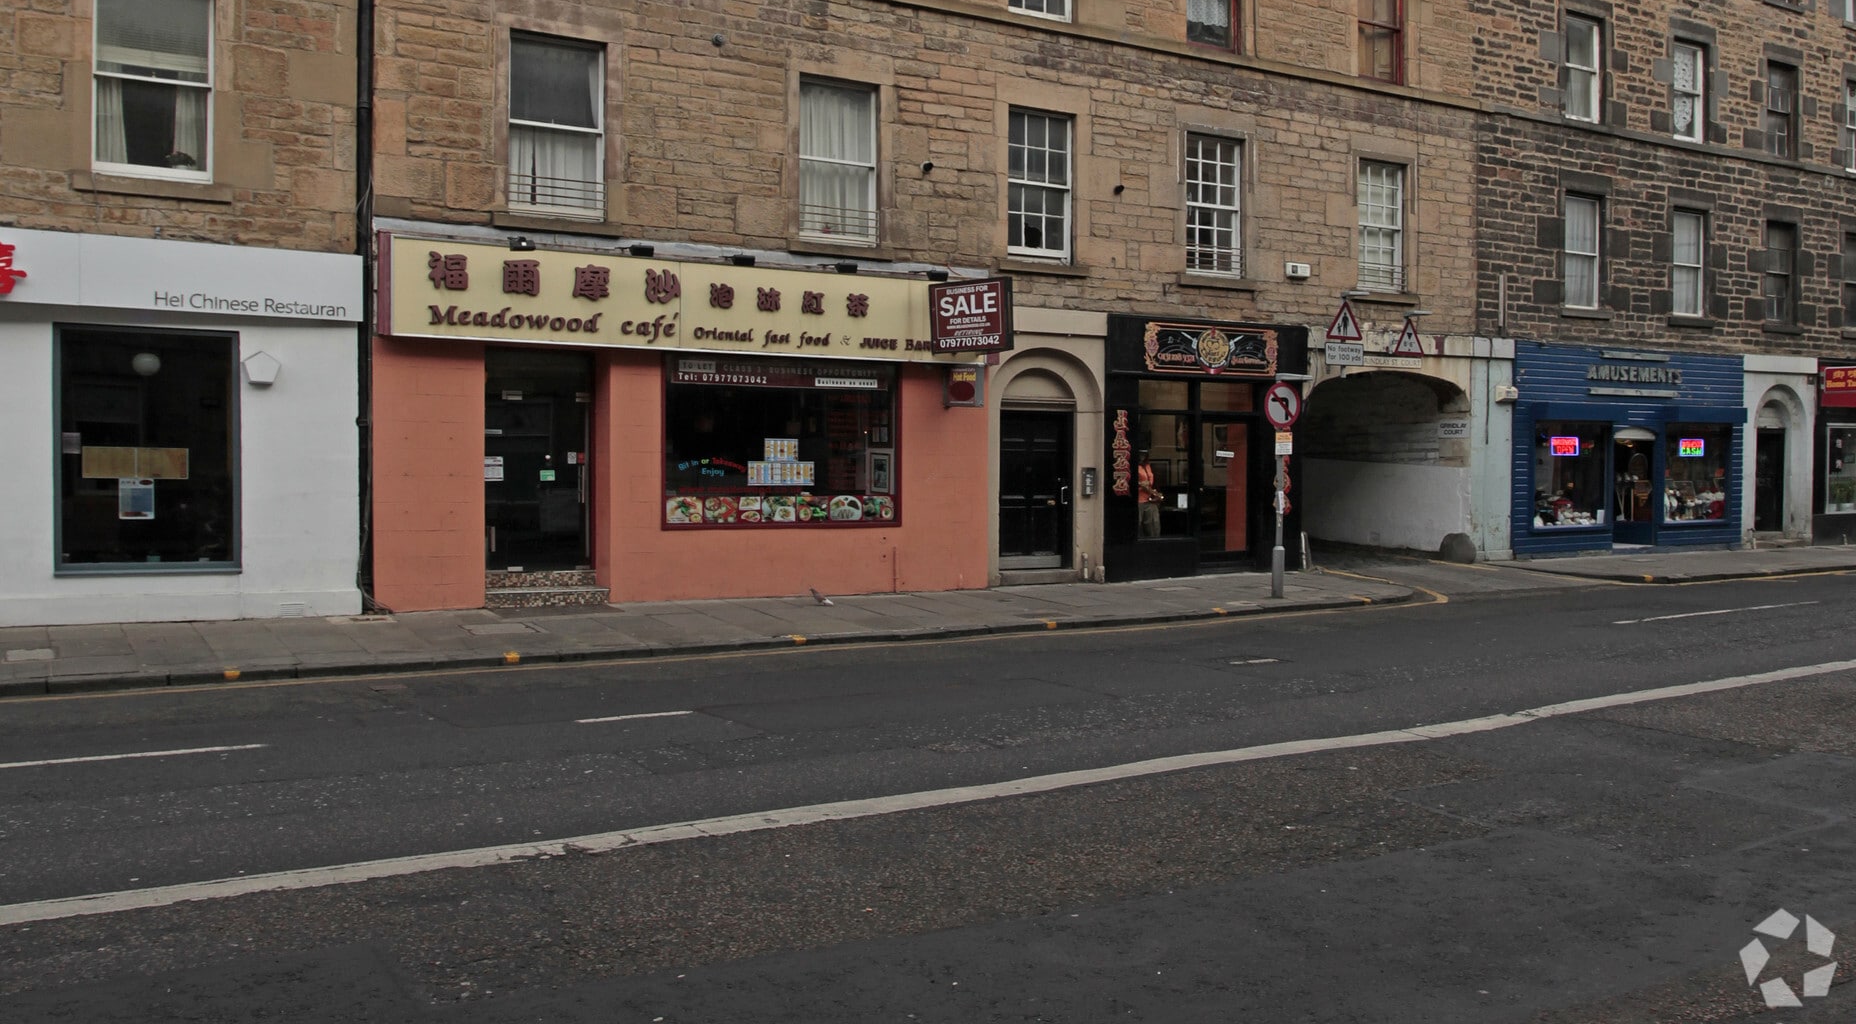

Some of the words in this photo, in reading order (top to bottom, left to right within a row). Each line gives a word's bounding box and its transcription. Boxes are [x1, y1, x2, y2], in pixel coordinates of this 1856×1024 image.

[946, 287, 975, 295] BUSINESS
[189, 292, 259, 313] Chinese
[264, 297, 347, 318] Restauran
[940, 292, 997, 317] SALE
[428, 304, 603, 333] Meadowood
[621, 312, 679, 343] café
[962, 316, 986, 324] DETAILS
[693, 326, 754, 343] Oriental
[762, 330, 791, 347] fast
[797, 332, 832, 349] food
[859, 336, 898, 351] JUICE
[940, 336, 1000, 348] 07977073042
[1327, 344, 1336, 352] No
[1338, 345, 1361, 354] footway
[1339, 353, 1350, 361] 100
[1351, 354, 1362, 362] yds
[1401, 359, 1420, 367] COURT
[768, 366, 813, 375] BUSINESS
[1587, 364, 1683, 384] AMUSEMENTS
[678, 372, 698, 381] Tel:
[702, 374, 767, 384] 07977073042
[1112, 409, 1131, 495] JAZZ
[1554, 445, 1575, 454] OPEN
[1681, 447, 1702, 455] CASH
[701, 467, 725, 477] Enjoy
